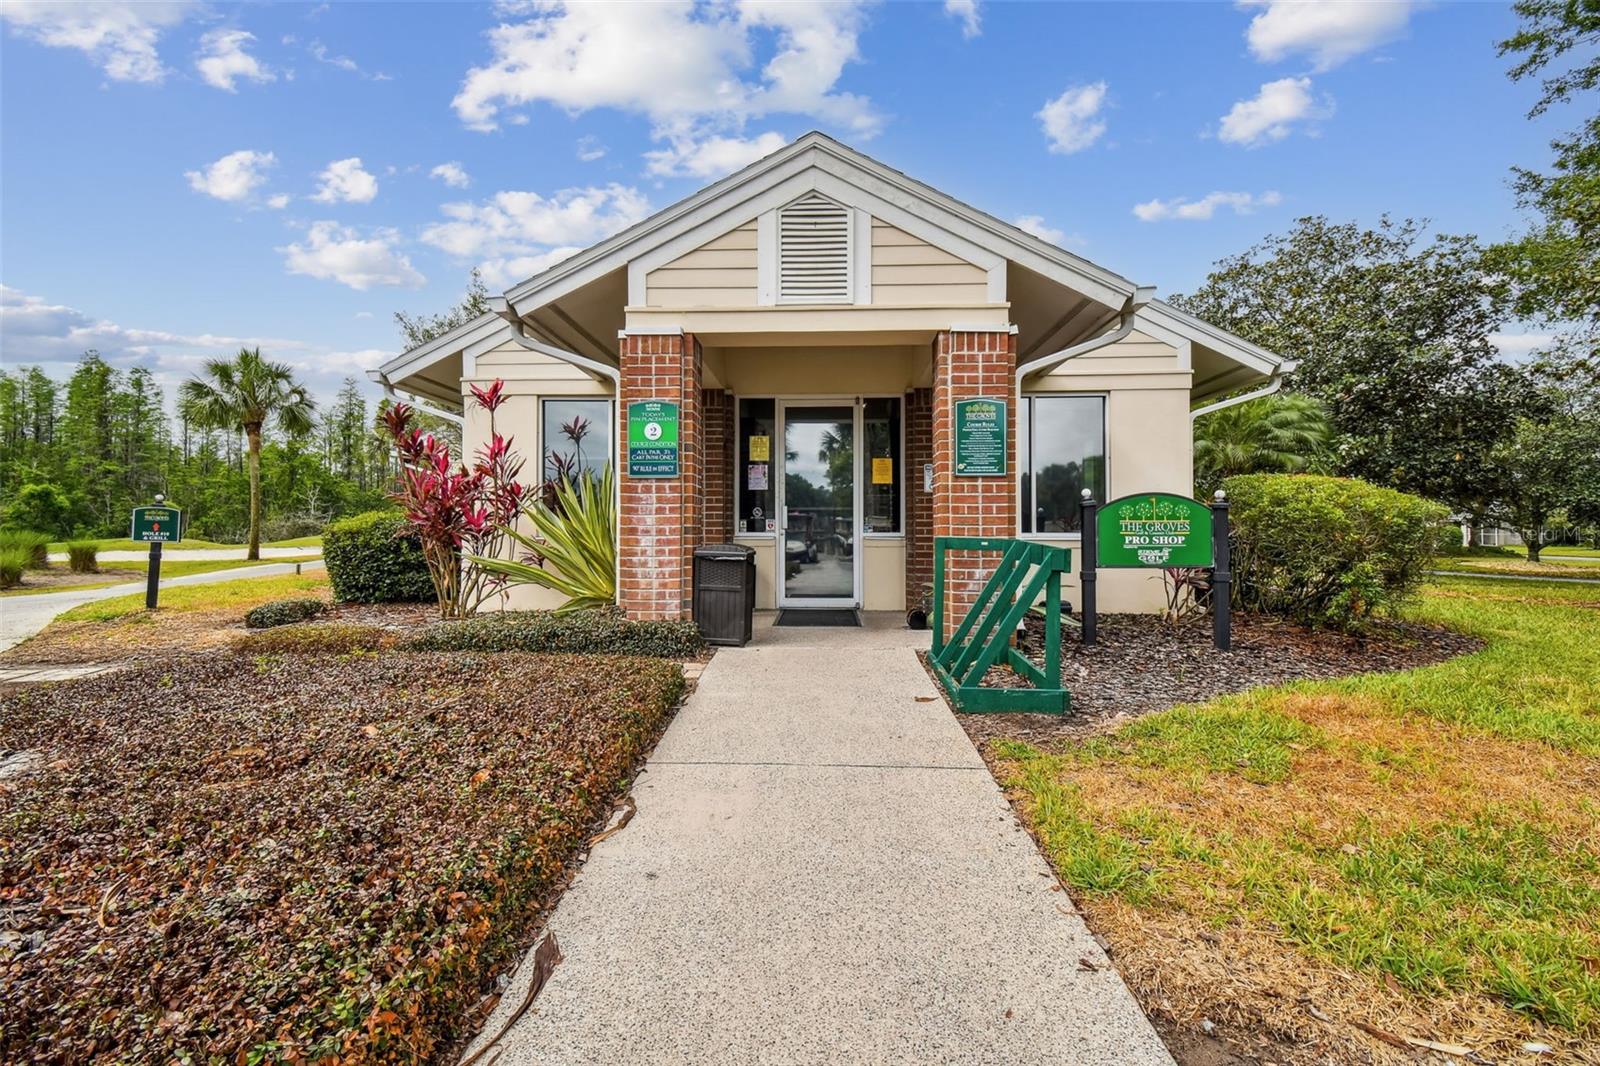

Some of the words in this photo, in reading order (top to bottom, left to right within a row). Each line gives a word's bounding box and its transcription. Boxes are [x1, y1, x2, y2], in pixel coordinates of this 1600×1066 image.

[650, 426, 657, 436] 2
[1120, 522, 1144, 532] THE
[1145, 521, 1190, 532] GROVES
[1124, 536, 1150, 545] PRO
[1152, 536, 1186, 545] SHOP
